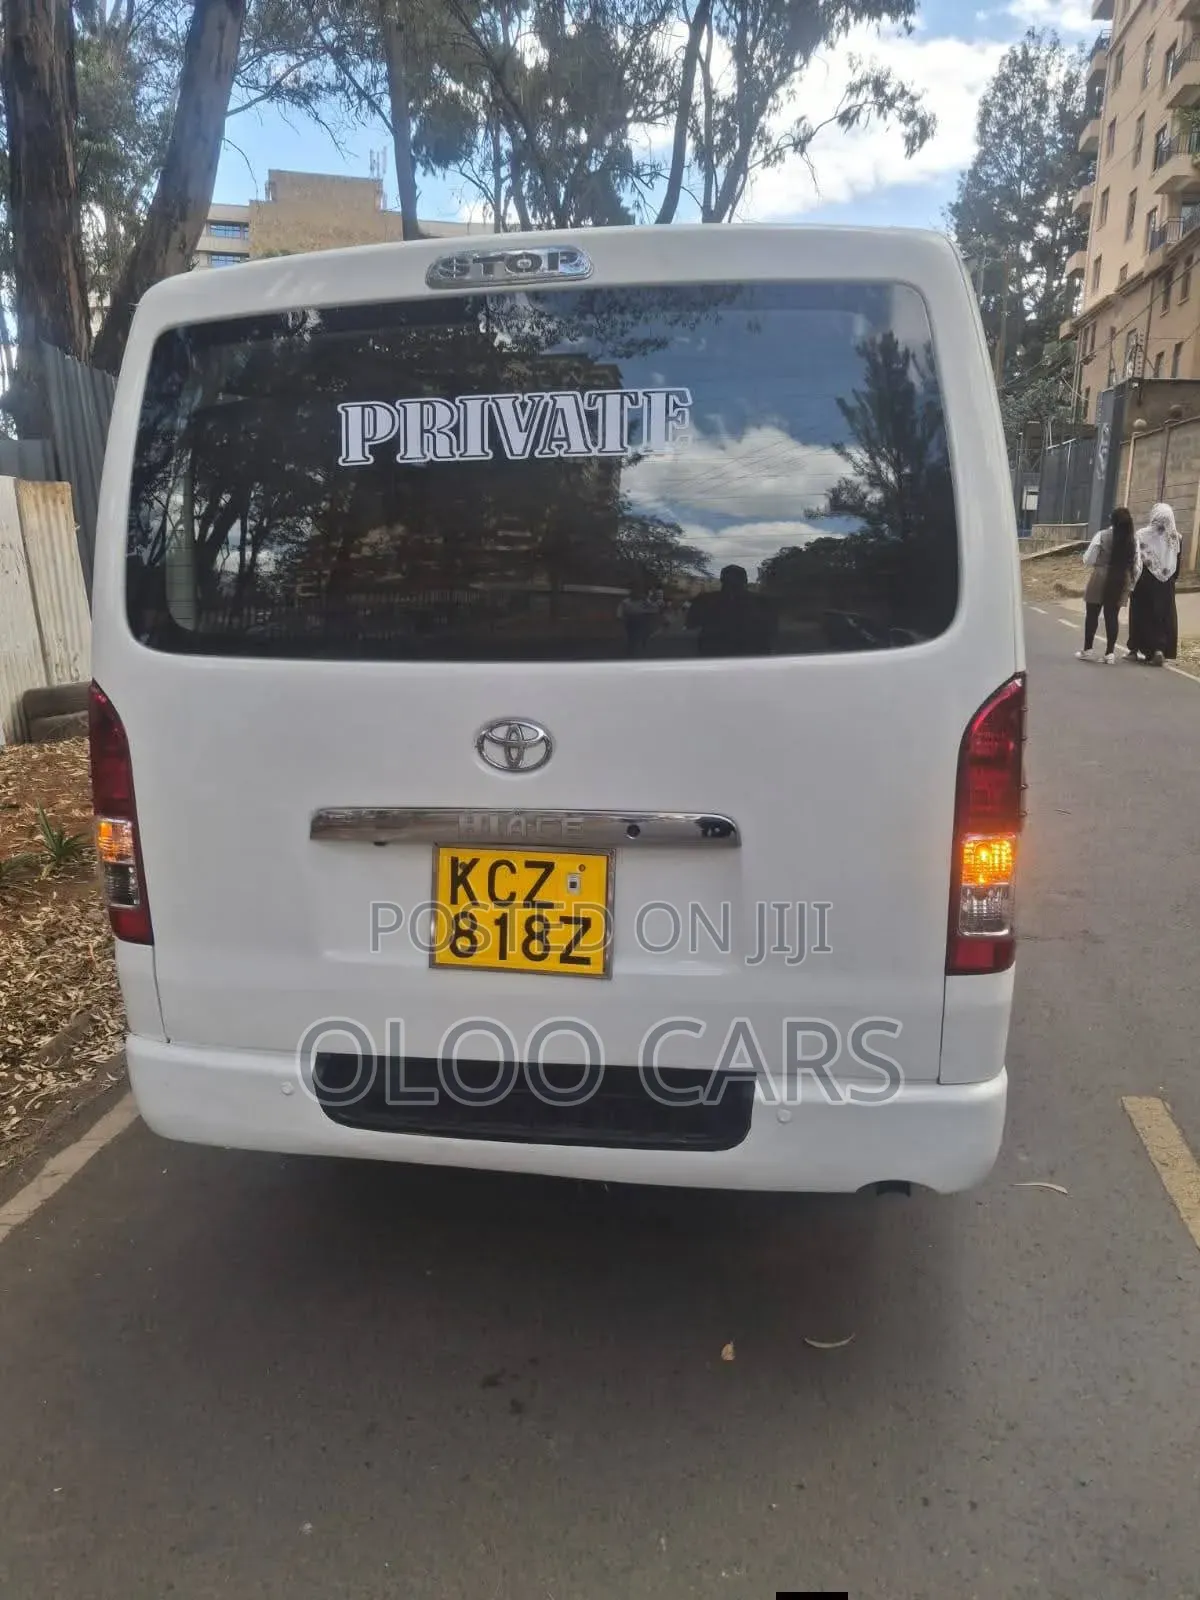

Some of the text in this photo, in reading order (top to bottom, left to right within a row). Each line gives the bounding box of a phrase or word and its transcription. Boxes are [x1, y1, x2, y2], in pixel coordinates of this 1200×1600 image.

[439, 249, 579, 278] STOP
[337, 387, 693, 467] PRIVATE
[450, 856, 555, 910] KCZ
[448, 910, 592, 966] 818Z
